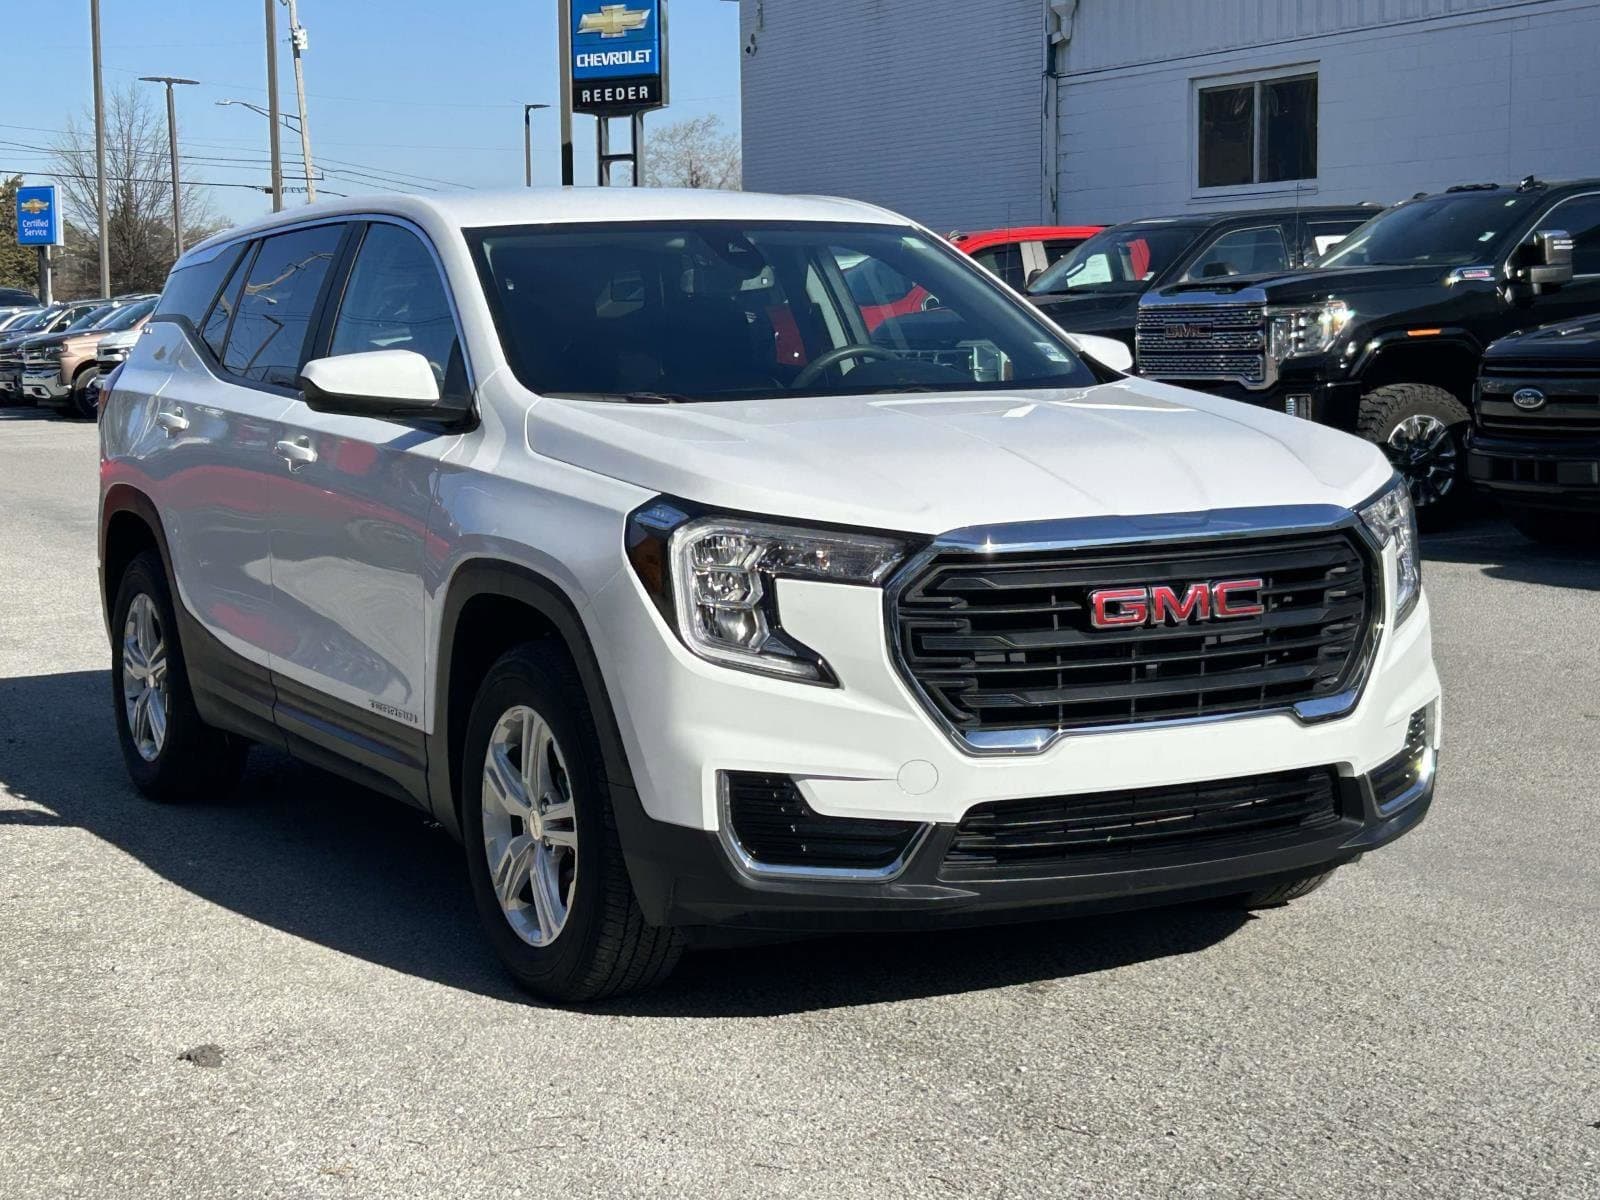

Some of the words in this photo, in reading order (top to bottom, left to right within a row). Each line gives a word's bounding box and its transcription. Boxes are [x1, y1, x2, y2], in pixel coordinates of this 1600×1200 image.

[576, 49, 652, 68] CHEVROLET
[582, 86, 648, 103] REEDER
[22, 219, 49, 228] Certified
[24, 228, 47, 237] Service
[1089, 578, 1265, 630] GMC
